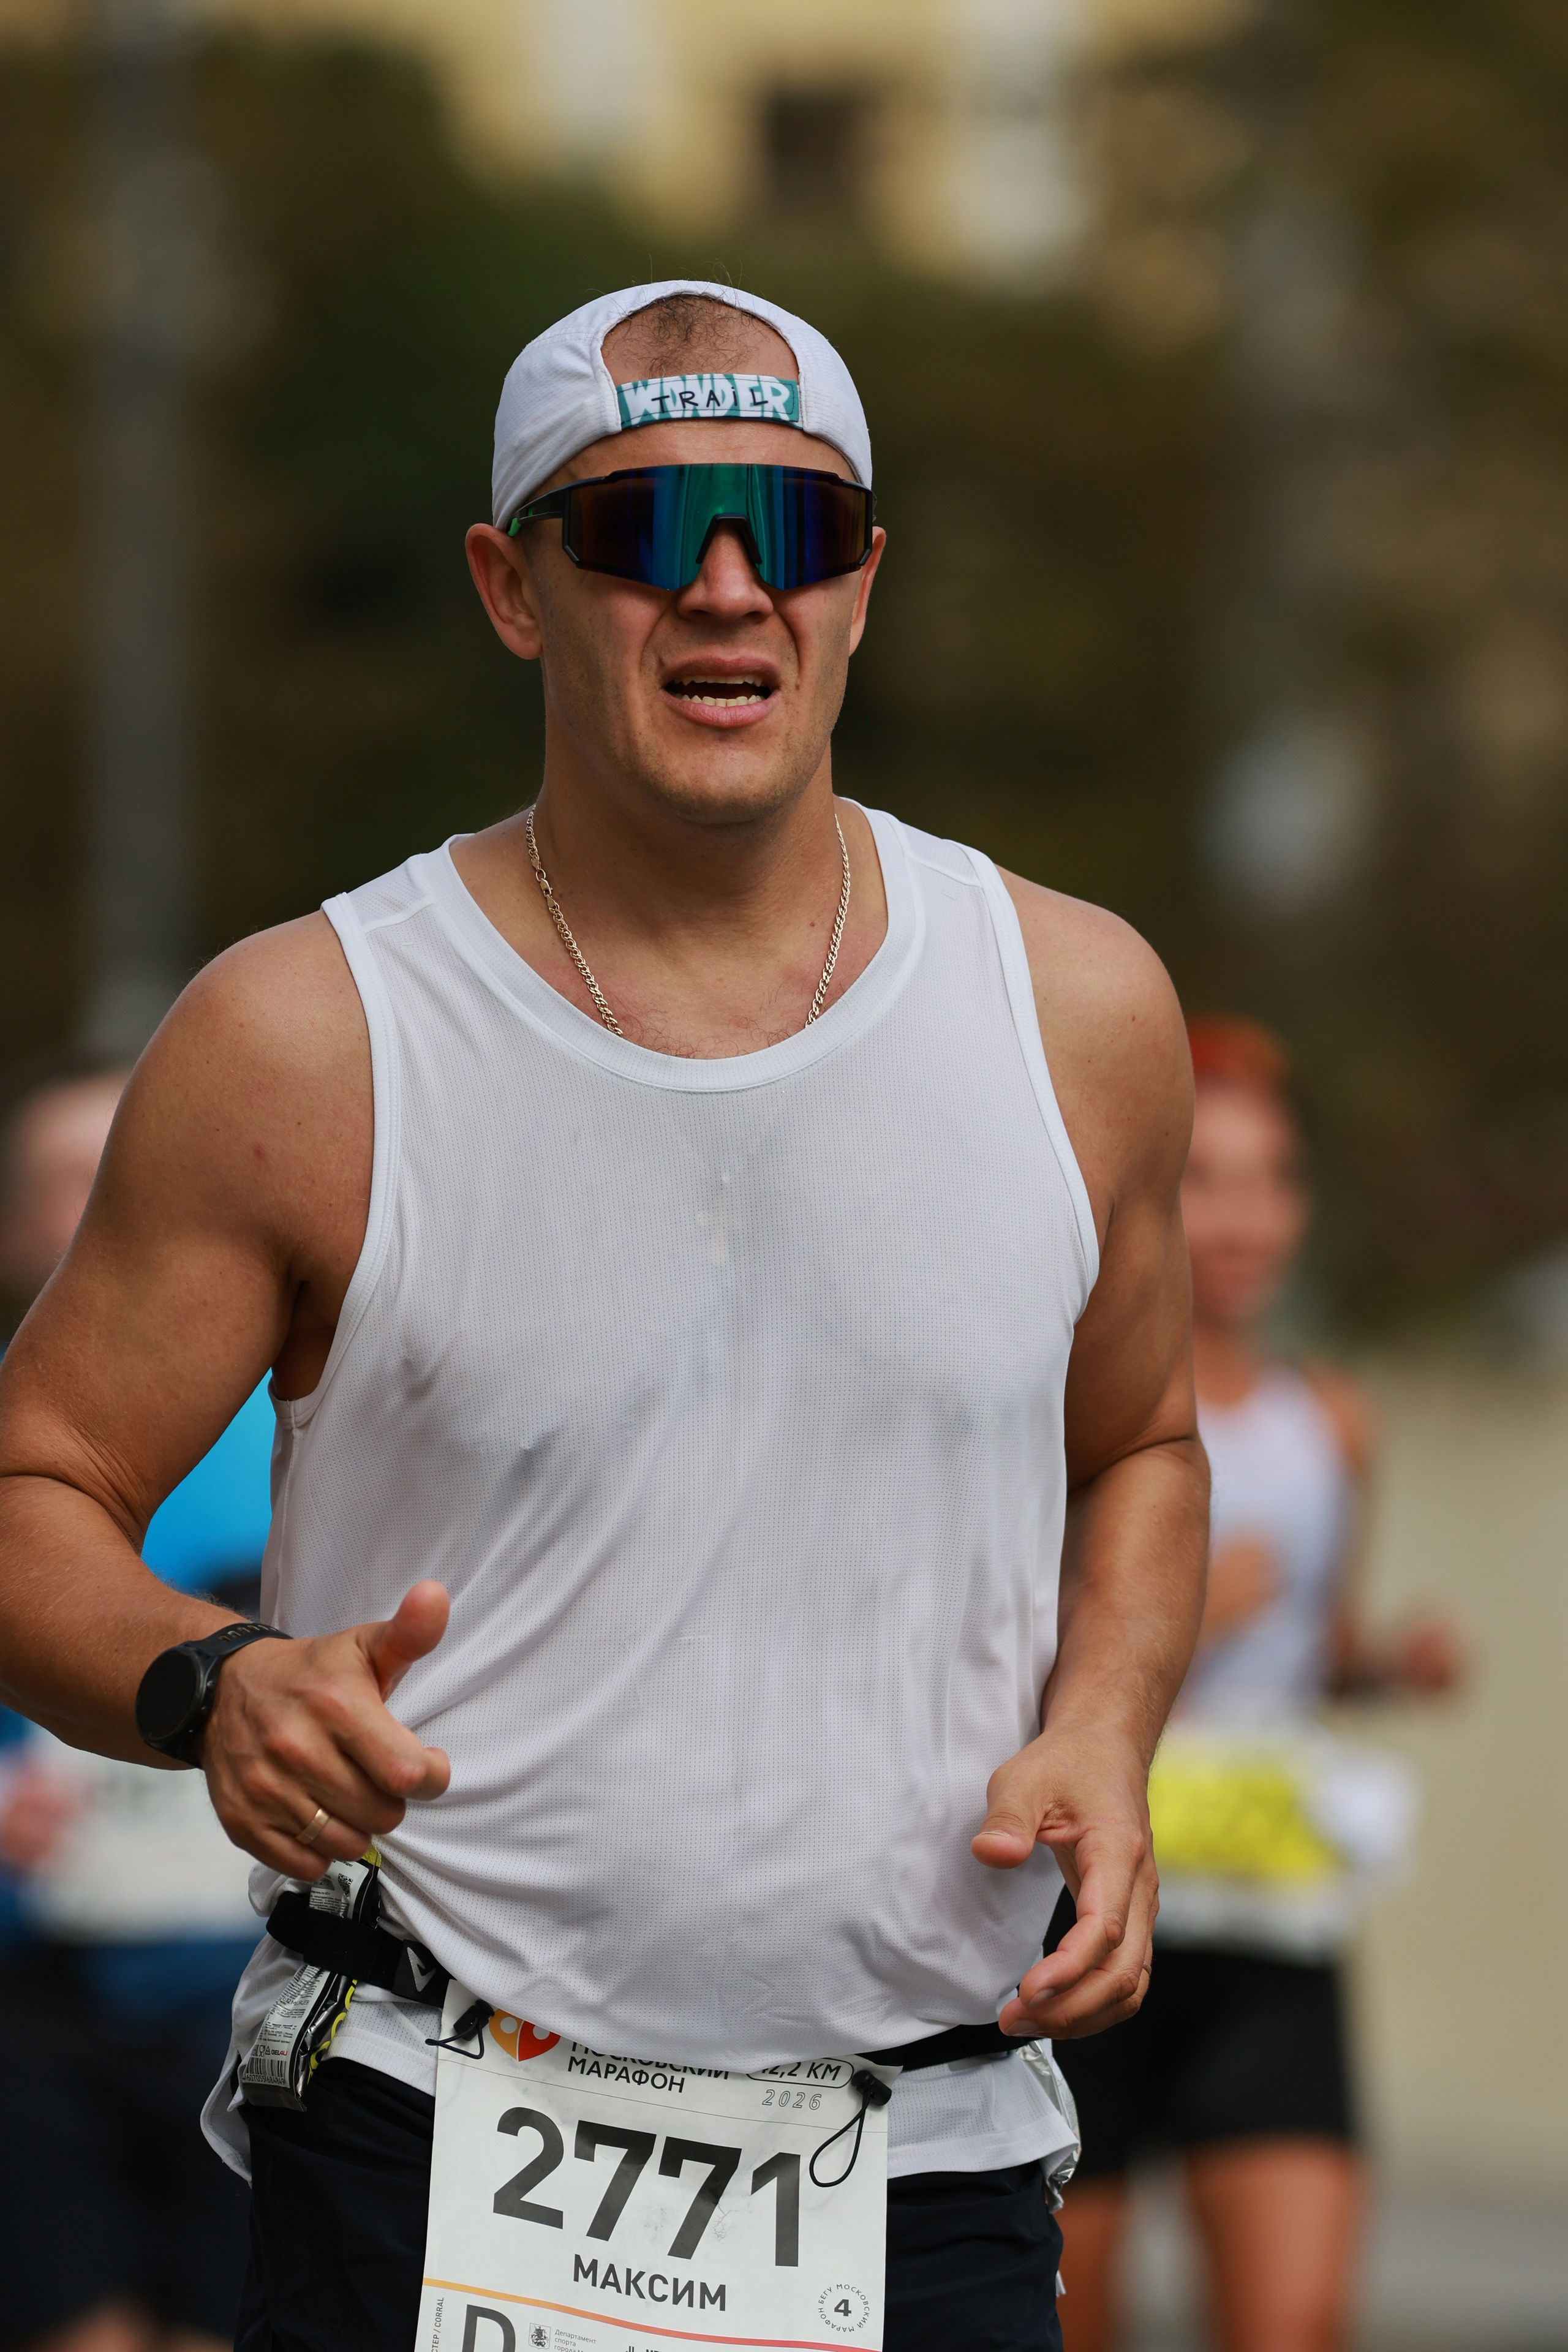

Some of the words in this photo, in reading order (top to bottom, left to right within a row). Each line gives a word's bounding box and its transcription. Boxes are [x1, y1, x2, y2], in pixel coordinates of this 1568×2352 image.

[621, 374, 790, 425] WONDER
[567, 2056, 685, 2093] МАРАФОН
[761, 2089, 822, 2111] 2026
[493, 2106, 801, 2267] 2771
[573, 2253, 726, 2312] МАКСИМ
[818, 2286, 832, 2304] БЕГУ
[434, 2297, 444, 2328] CORRAL
[818, 2307, 854, 2332] МАРАФОН
[834, 2299, 852, 2316] 4
[836, 2284, 870, 2329] МОСКОВСКИЙ
[461, 2304, 516, 2352] D
[554, 2329, 597, 2344] Департамент
[554, 2337, 576, 2346] спорта
